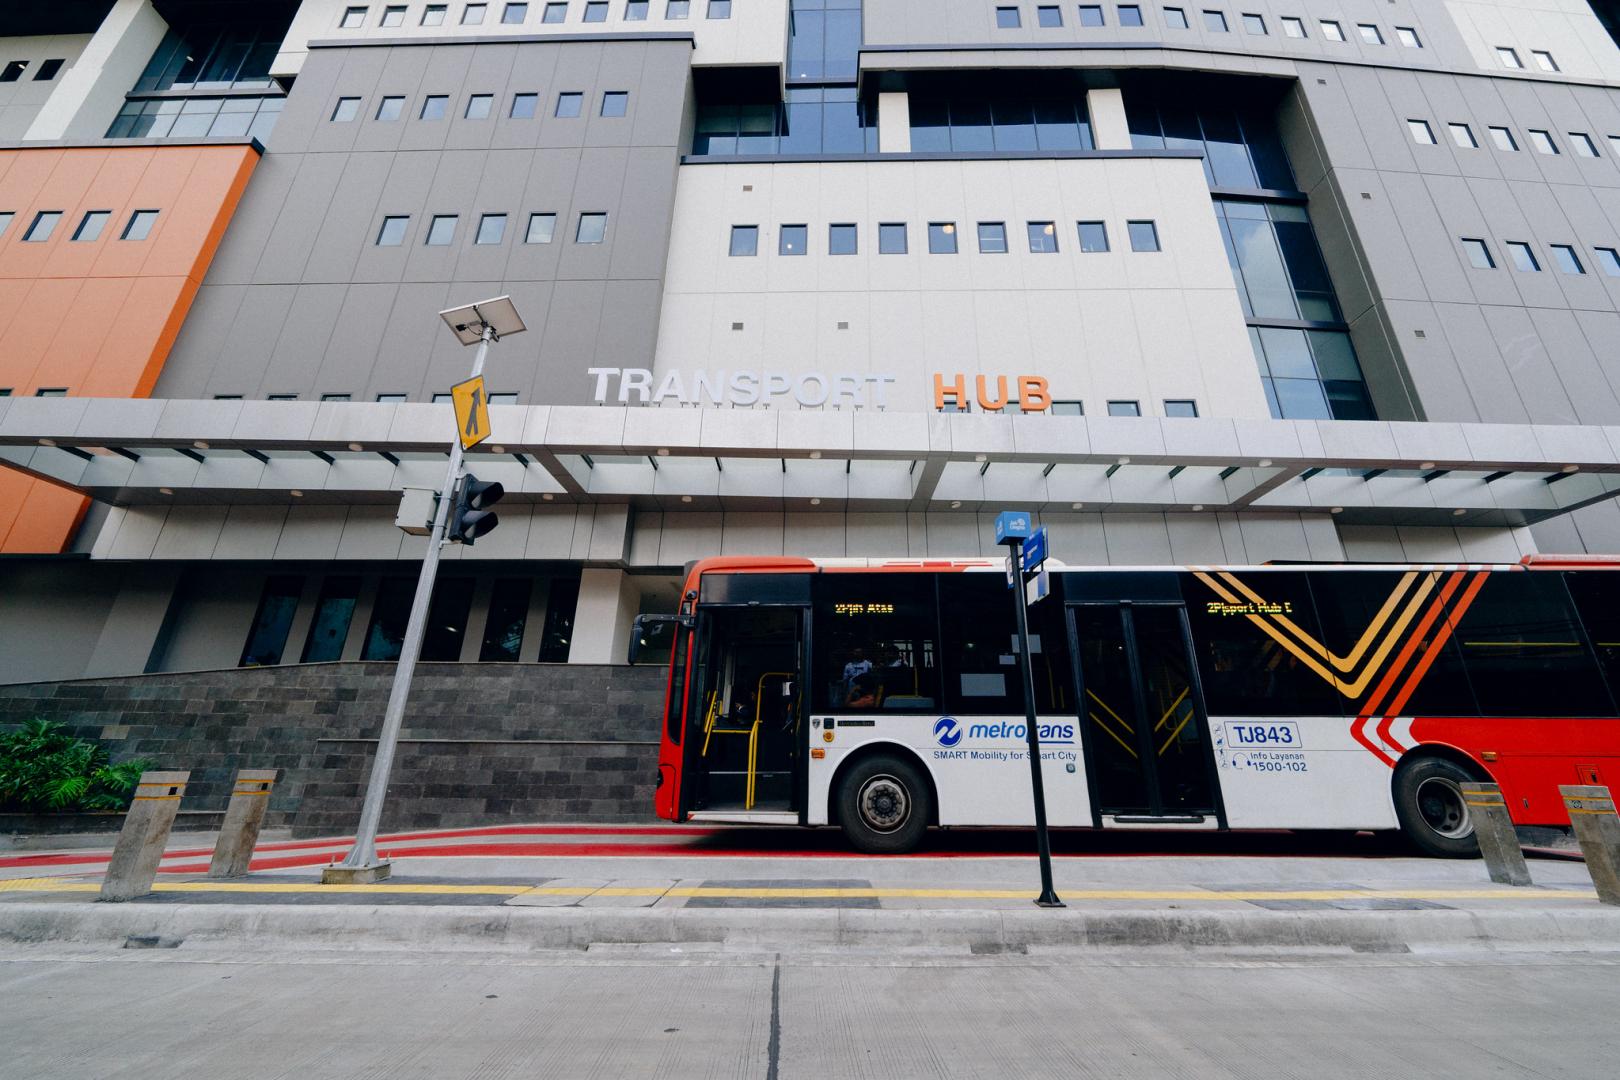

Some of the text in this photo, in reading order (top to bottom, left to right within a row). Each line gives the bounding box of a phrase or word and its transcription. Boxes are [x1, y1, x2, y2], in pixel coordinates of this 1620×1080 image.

[588, 367, 1052, 411] TRANSPORT HUB
[1258, 602, 1282, 613] Hub
[969, 721, 1074, 739] metroans
[1233, 726, 1293, 743] TJ843
[934, 751, 1077, 762] SMART Mobility for Sart City
[1250, 752, 1305, 761] Info Layanan
[1252, 762, 1308, 772] 1500-102
